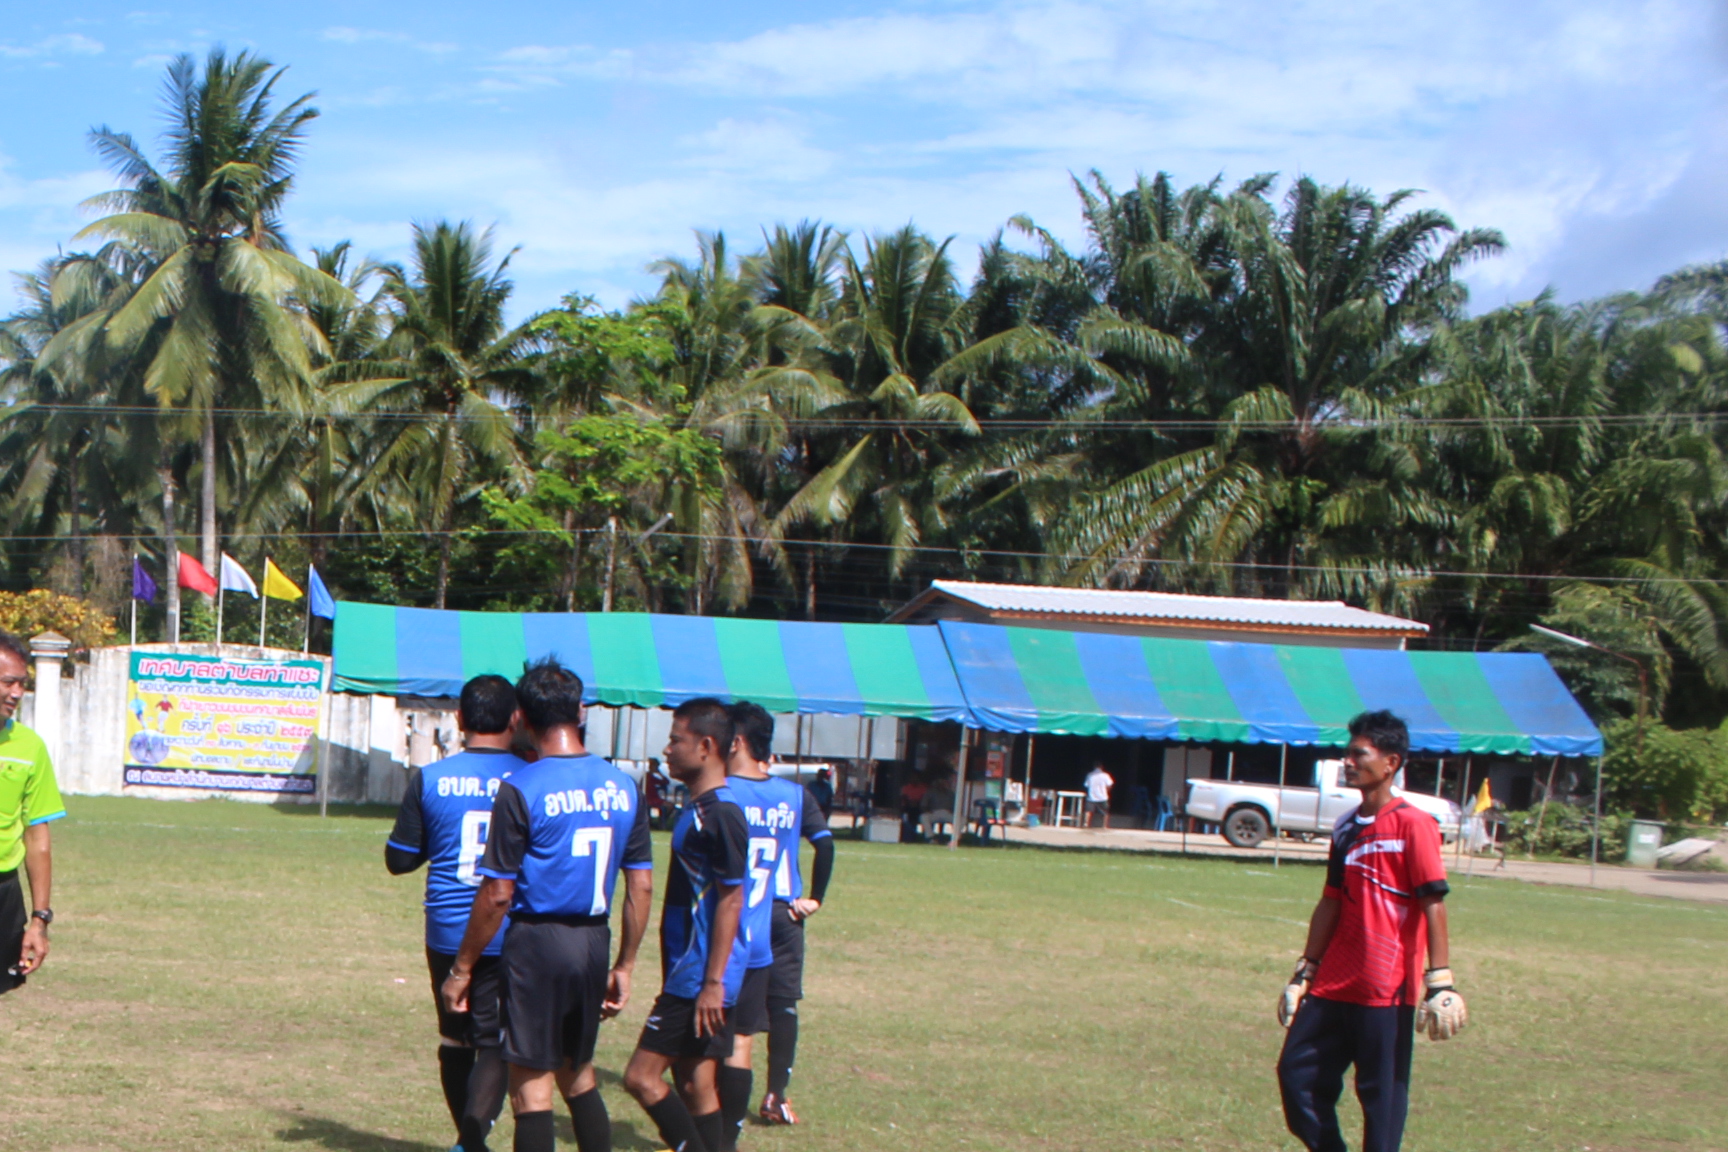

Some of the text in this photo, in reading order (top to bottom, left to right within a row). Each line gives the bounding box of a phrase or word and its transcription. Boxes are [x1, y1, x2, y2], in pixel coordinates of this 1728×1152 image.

[139, 658, 319, 682] เทศบาลตำบลท่าแซะ
[571, 826, 613, 916] 7
